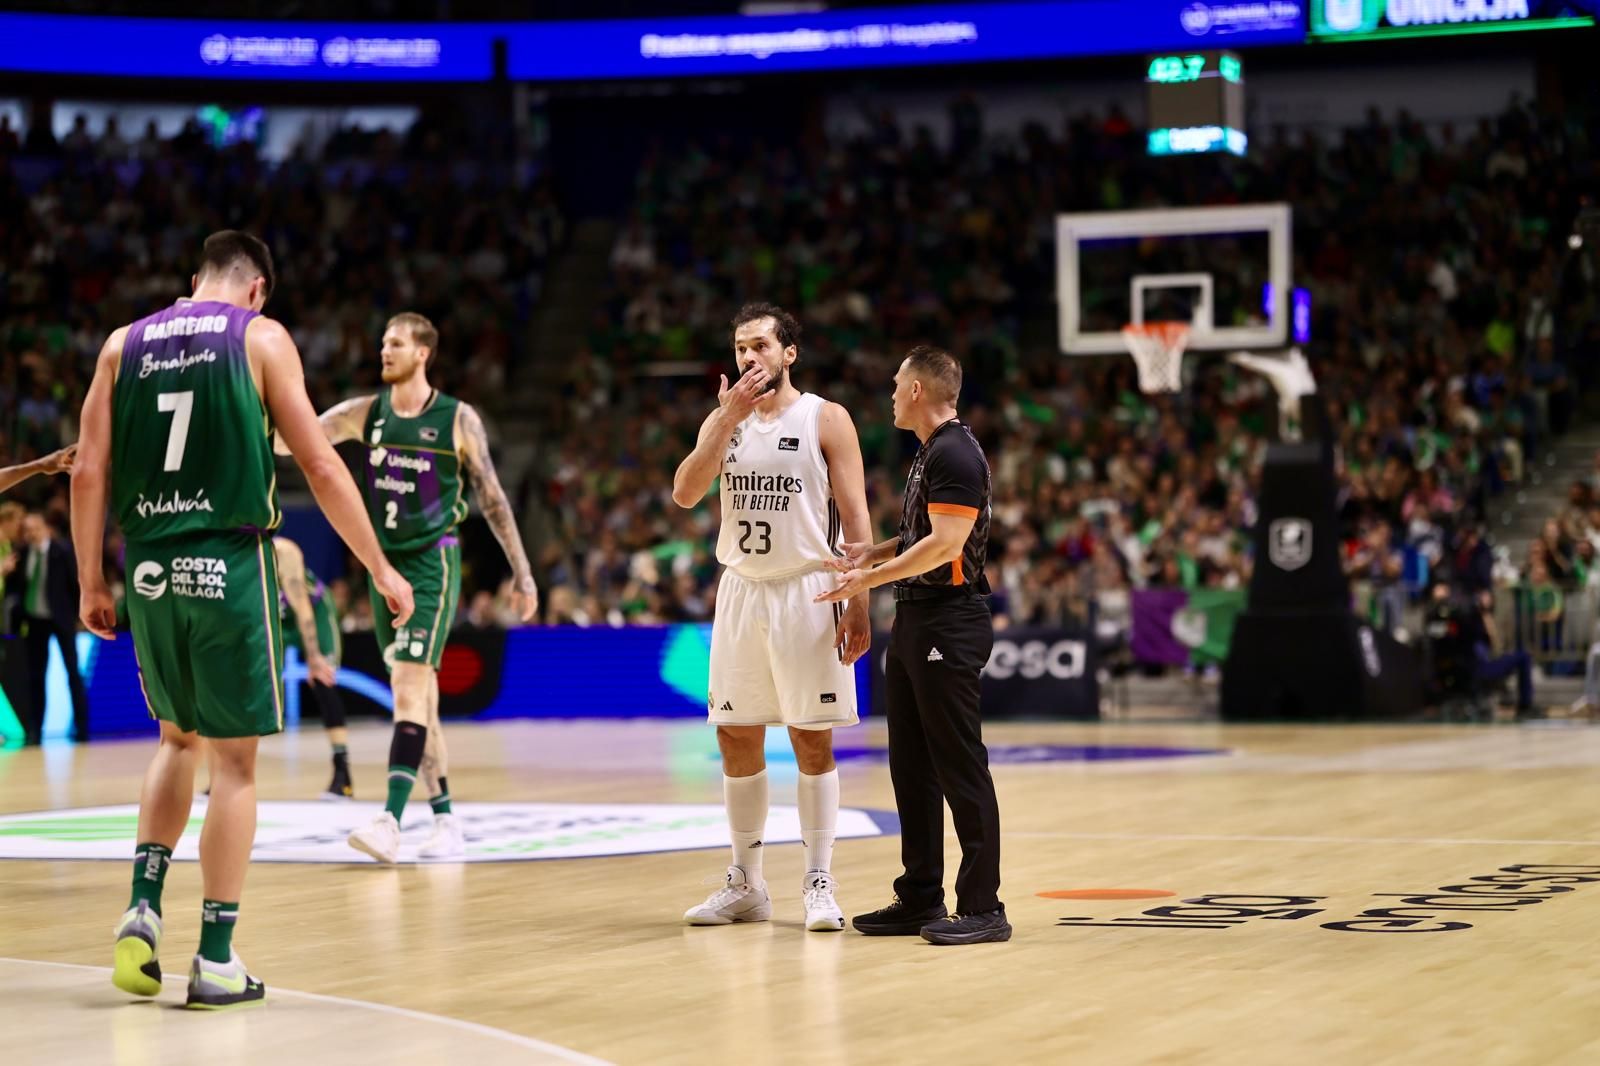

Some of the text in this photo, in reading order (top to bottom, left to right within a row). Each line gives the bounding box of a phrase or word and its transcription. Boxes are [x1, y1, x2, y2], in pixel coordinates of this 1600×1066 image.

[157, 391, 194, 472] 7
[724, 470, 803, 494] Emirates
[732, 494, 790, 512] FLY BETTER
[384, 501, 398, 530] 2
[738, 520, 772, 555] 23
[171, 557, 227, 575] COSTA
[171, 572, 227, 588] DEL SOL
